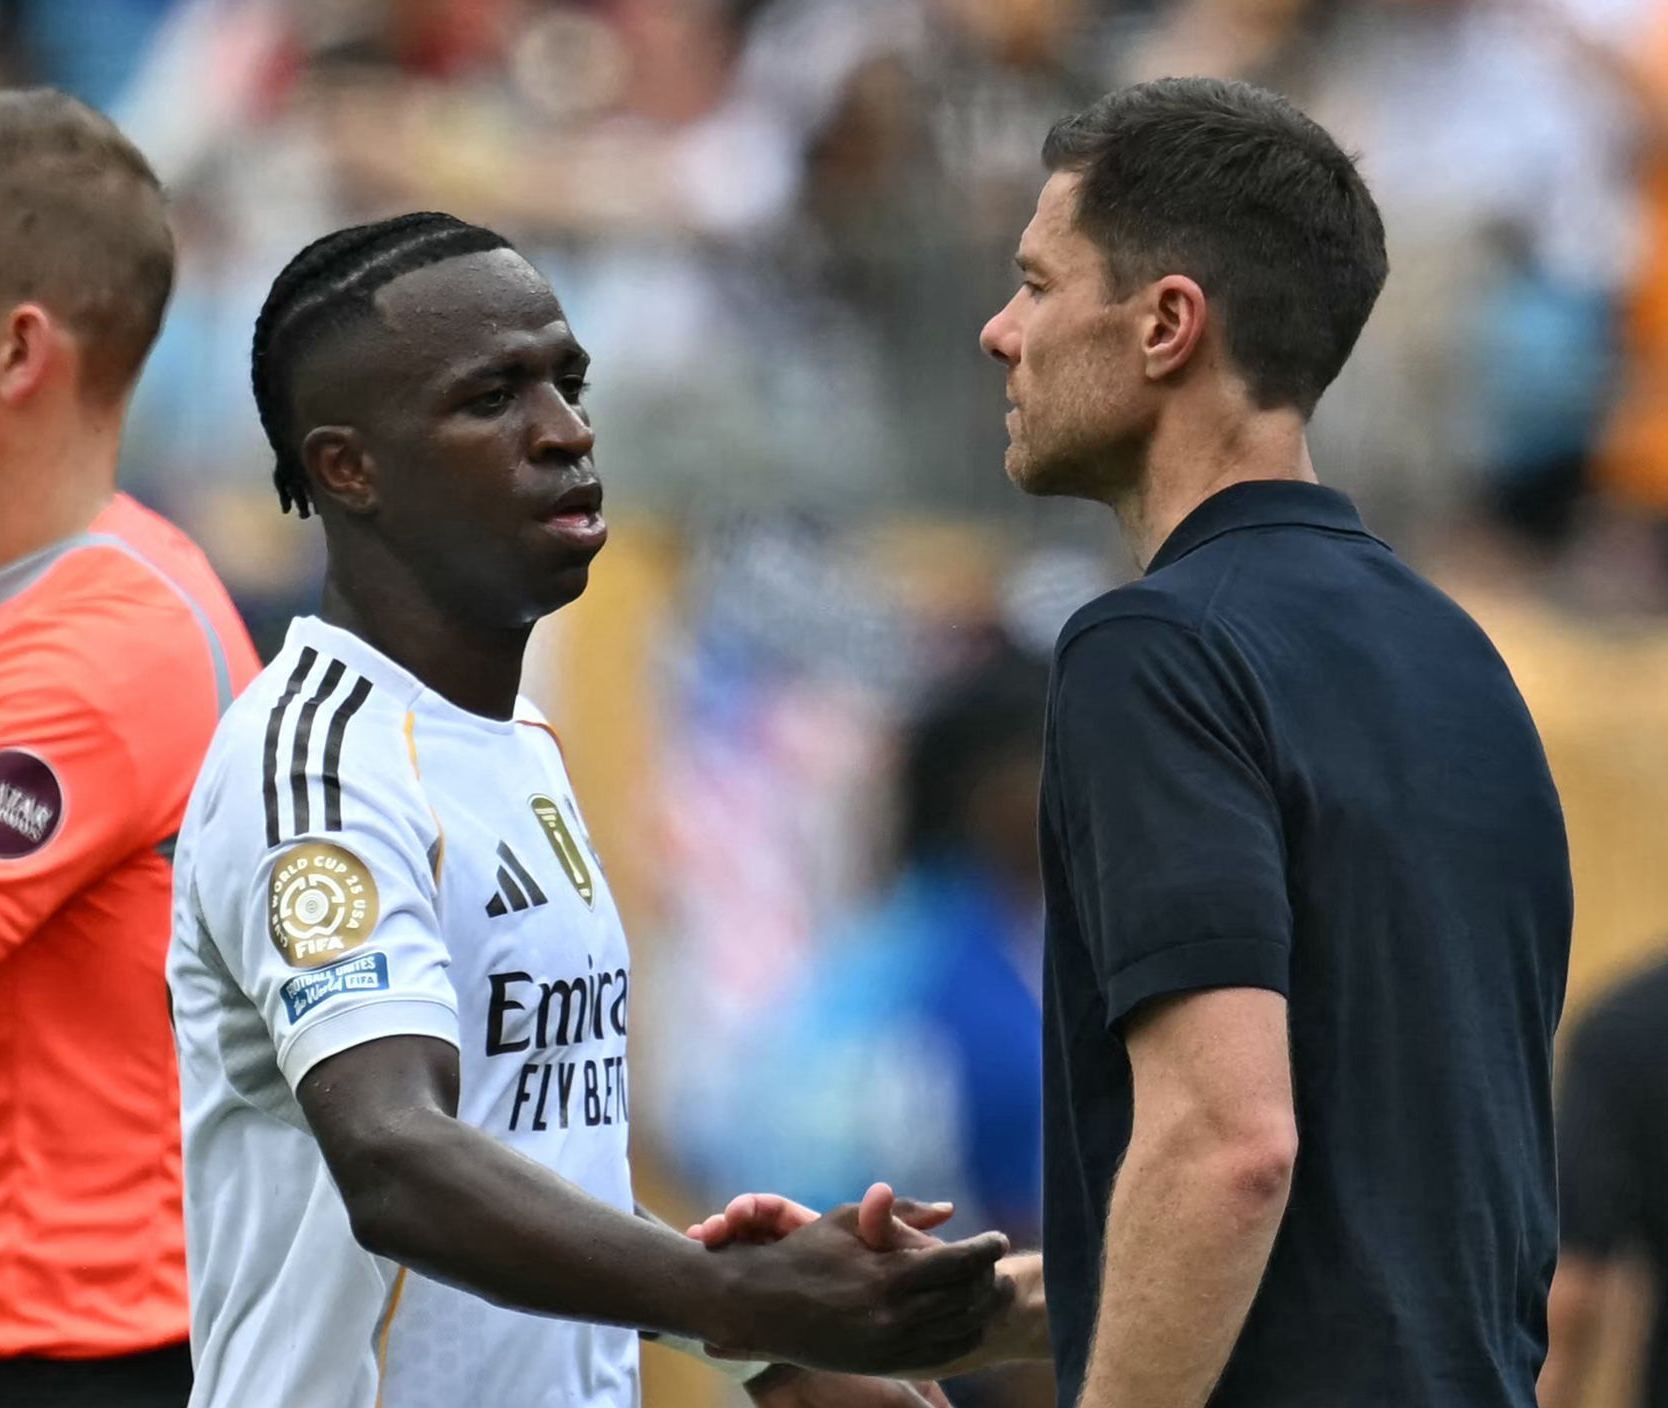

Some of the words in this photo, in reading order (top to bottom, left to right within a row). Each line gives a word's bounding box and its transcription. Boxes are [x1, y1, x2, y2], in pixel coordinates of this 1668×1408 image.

[313, 855, 347, 873] CUP
[272, 858, 308, 908] WORLD
[346, 875, 364, 895] 25
[345, 899, 366, 929] USA
[294, 935, 344, 959] FIFA
[335, 956, 376, 976] UNITES
[349, 976, 375, 985] FIFA
[508, 1062, 576, 1132] FLY
[583, 1056, 629, 1127] BET
